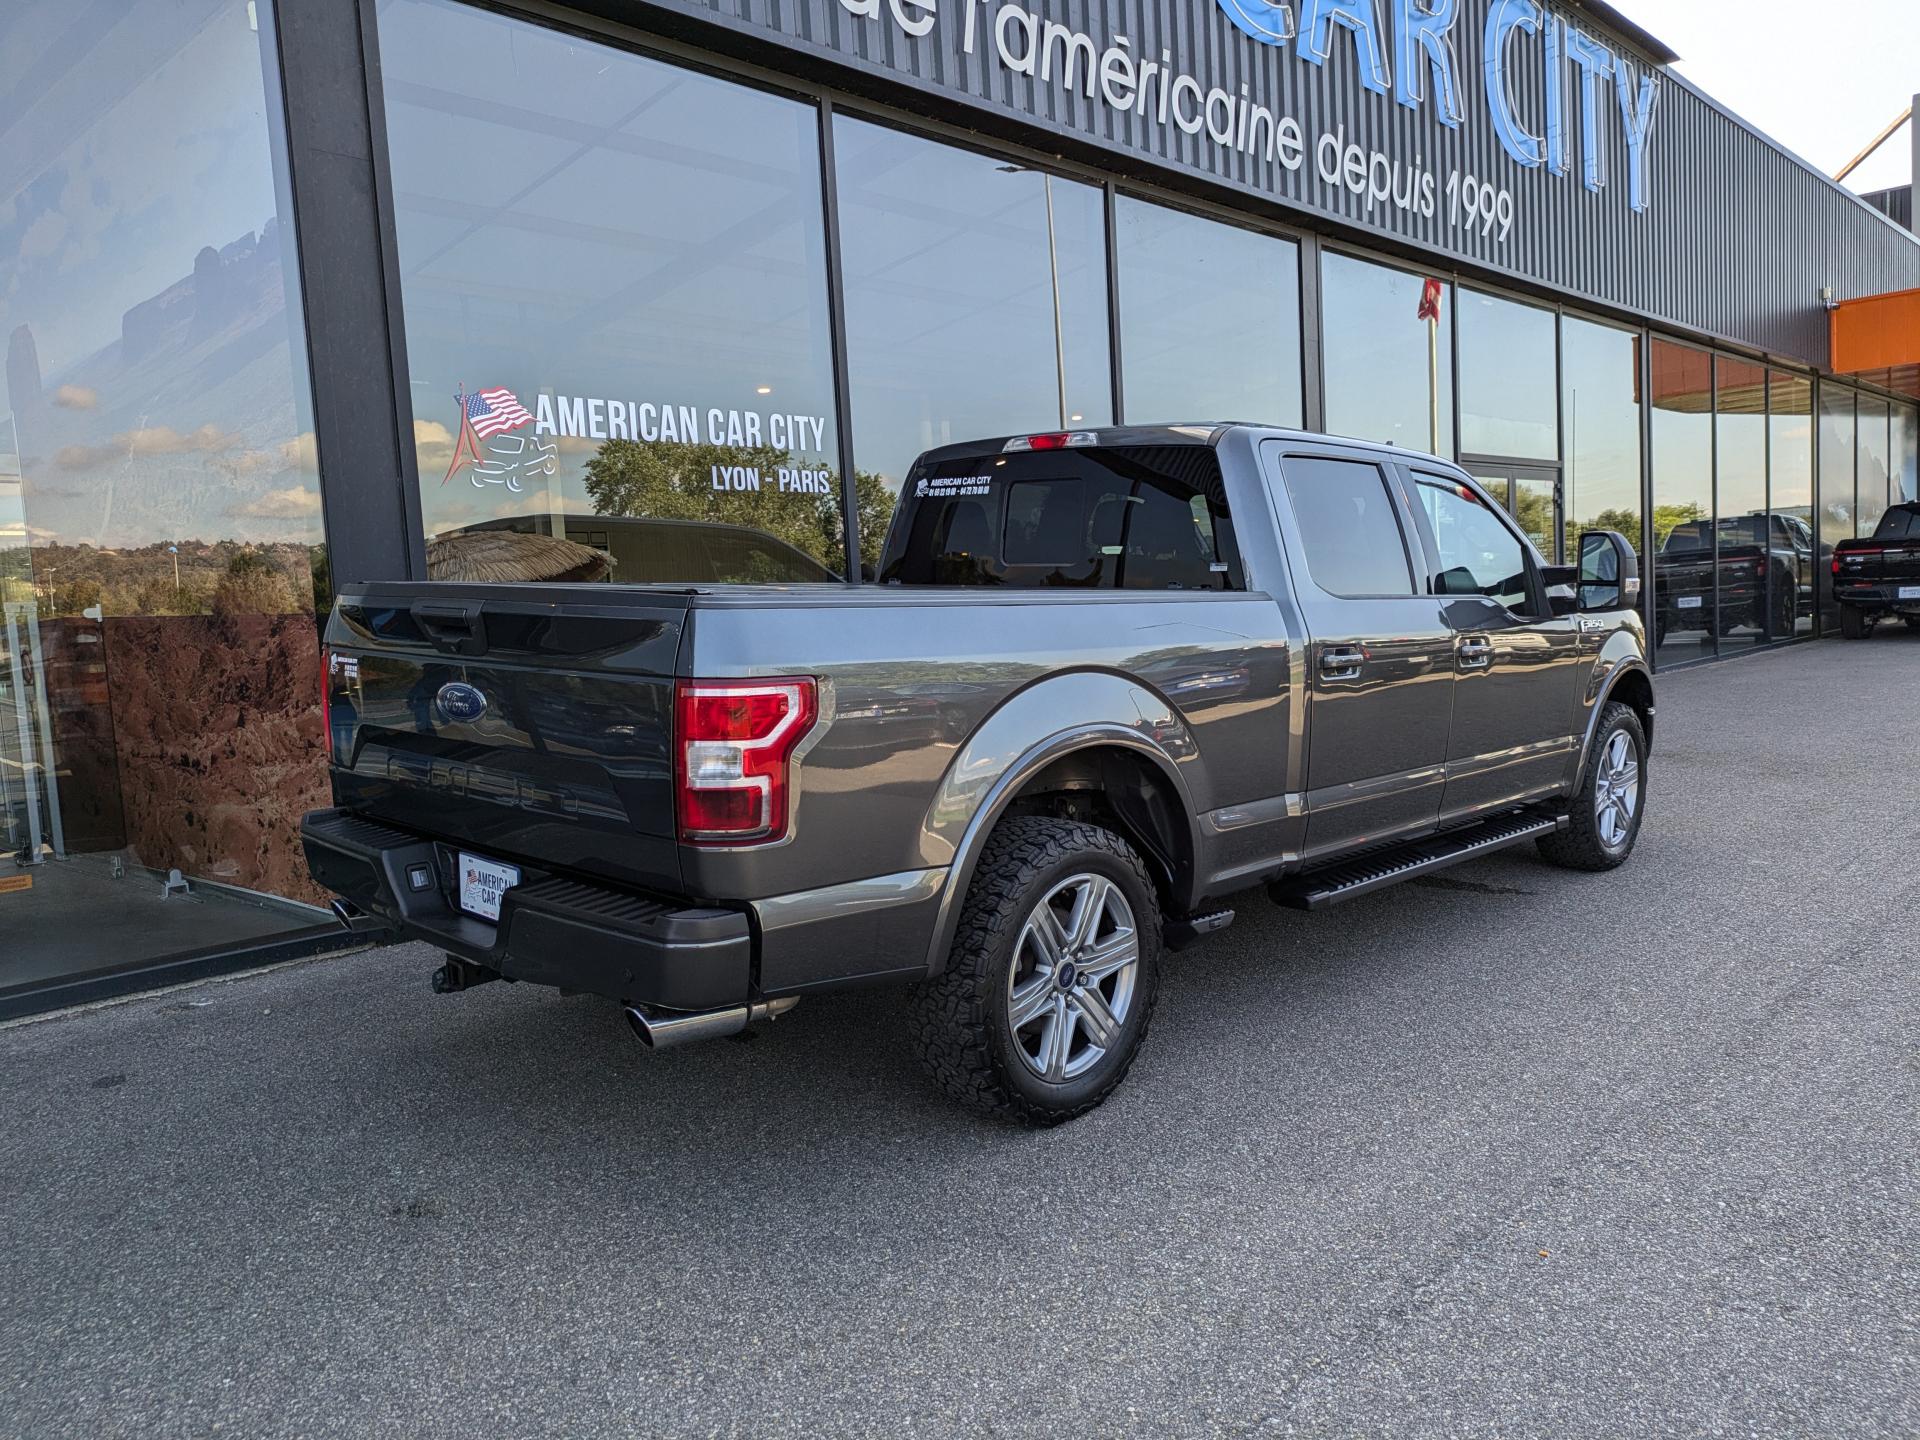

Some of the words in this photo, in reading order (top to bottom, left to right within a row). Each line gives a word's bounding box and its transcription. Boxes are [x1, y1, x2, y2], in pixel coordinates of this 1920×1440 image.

[1484, 0, 1661, 214] CITY
[1317, 123, 1436, 217] depuis
[1444, 171, 1514, 242] 1999
[535, 394, 699, 444] AMERICAN
[707, 408, 762, 448] CAR
[770, 413, 824, 452] CITY
[711, 465, 760, 492] LYON
[779, 468, 831, 494] PARIS
[931, 478, 962, 486] AMERICAN
[963, 477, 976, 485] CAR
[977, 476, 992, 484] CITY
[482, 888, 497, 906] CAR
